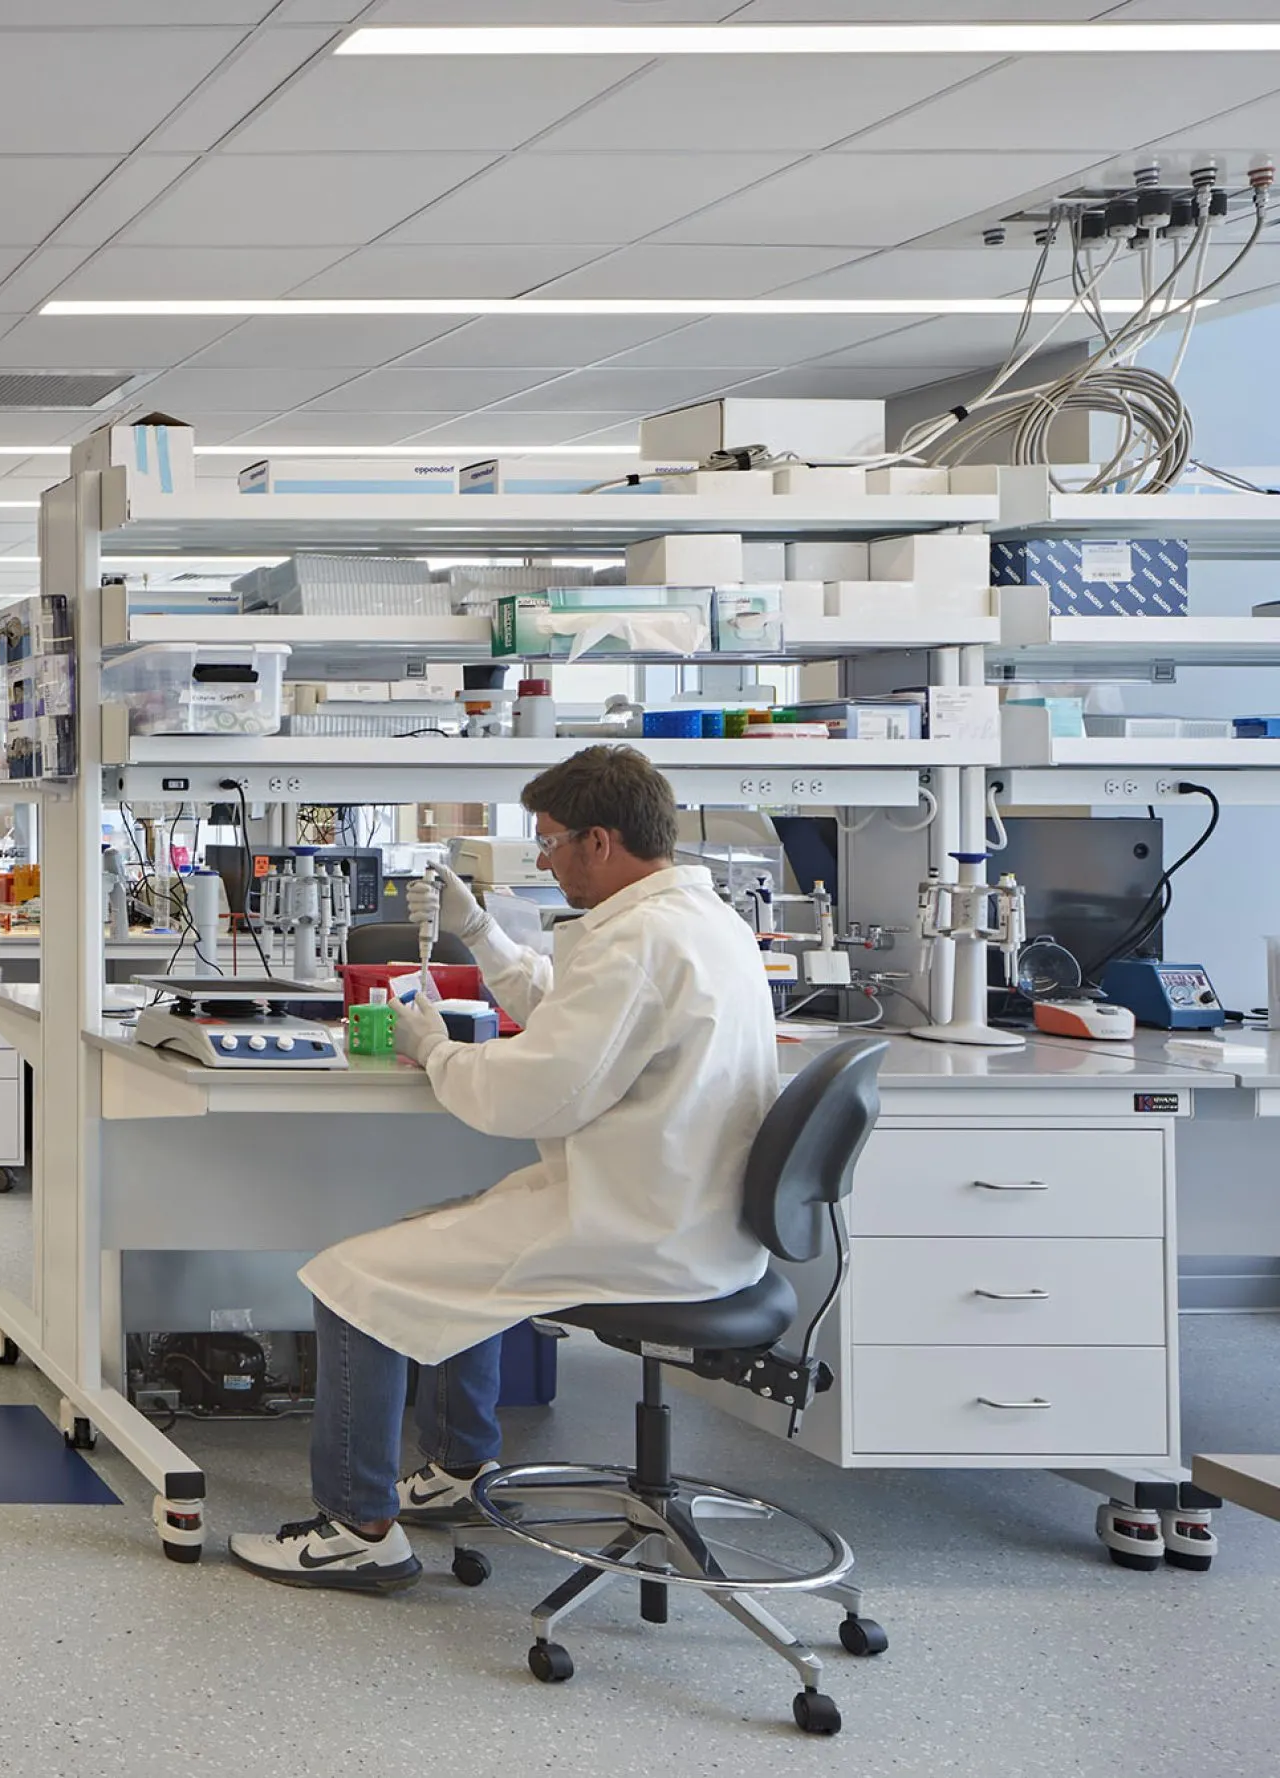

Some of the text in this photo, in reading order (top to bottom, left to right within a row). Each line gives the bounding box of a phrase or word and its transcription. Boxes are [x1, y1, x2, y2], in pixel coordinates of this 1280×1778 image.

[414, 466, 455, 475] eppendorf
[1131, 542, 1152, 562] QIAGEN
[1157, 552, 1179, 572] QIAGEN
[1047, 554, 1067, 574] QIAGEN
[1141, 567, 1163, 588] QIAGEN
[1057, 579, 1078, 599] QIAGEN
[1125, 583, 1147, 604] QIAGEN
[1083, 589, 1105, 610] QIAGEN
[1152, 593, 1173, 614] QIAGEN
